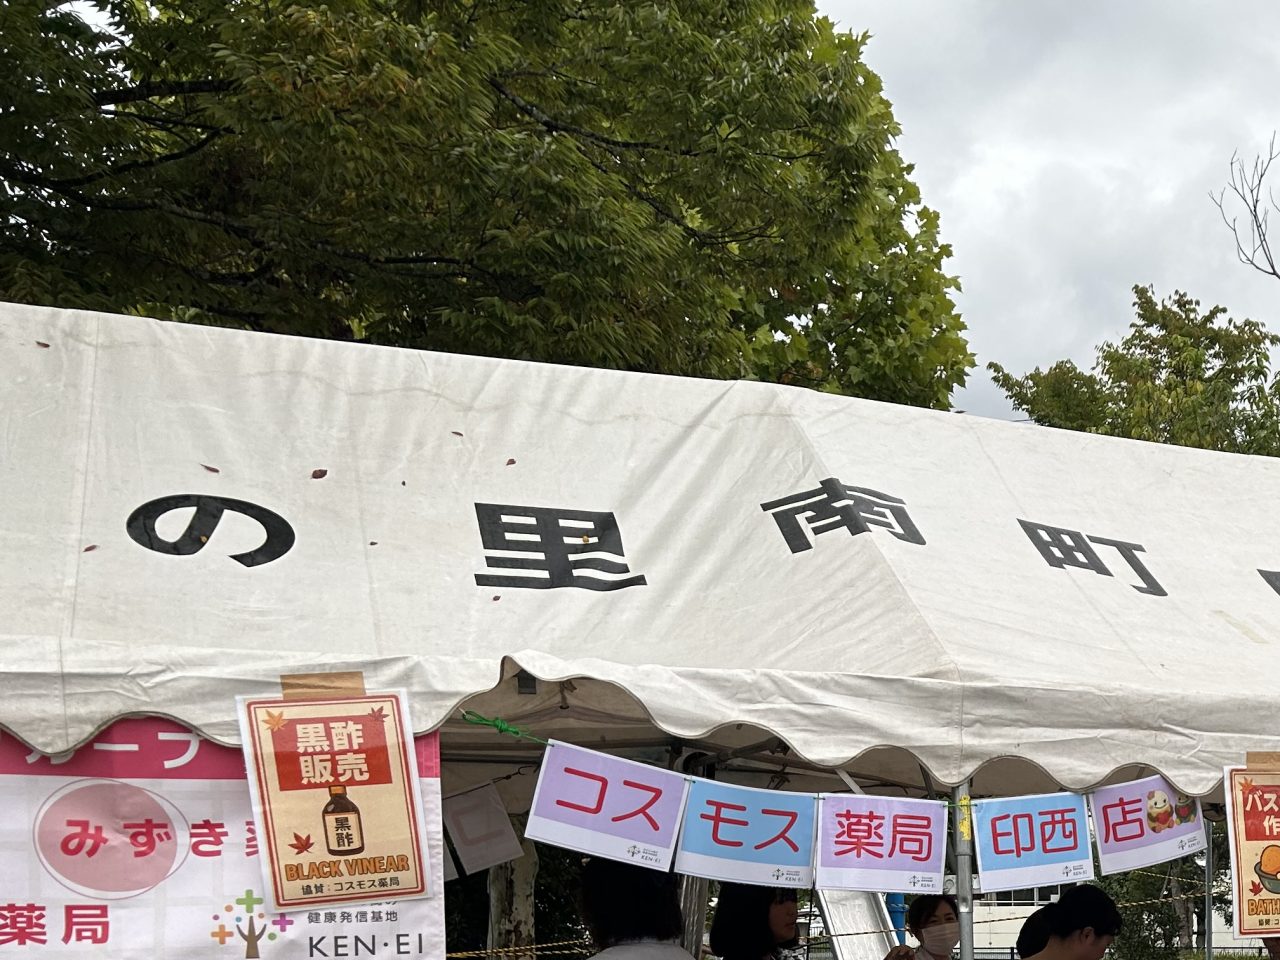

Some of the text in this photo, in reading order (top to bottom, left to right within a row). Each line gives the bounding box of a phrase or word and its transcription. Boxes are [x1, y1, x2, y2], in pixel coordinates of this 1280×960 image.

[296, 720, 364, 753] 黒酢
[299, 752, 370, 784] 販売
[335, 817, 354, 848] 黒酢
[285, 854, 409, 881] BLACK VINEAR
[307, 911, 398, 923] 健康発信基地
[1248, 898, 1280, 916] BATH
[0, 903, 110, 945] 薬局
